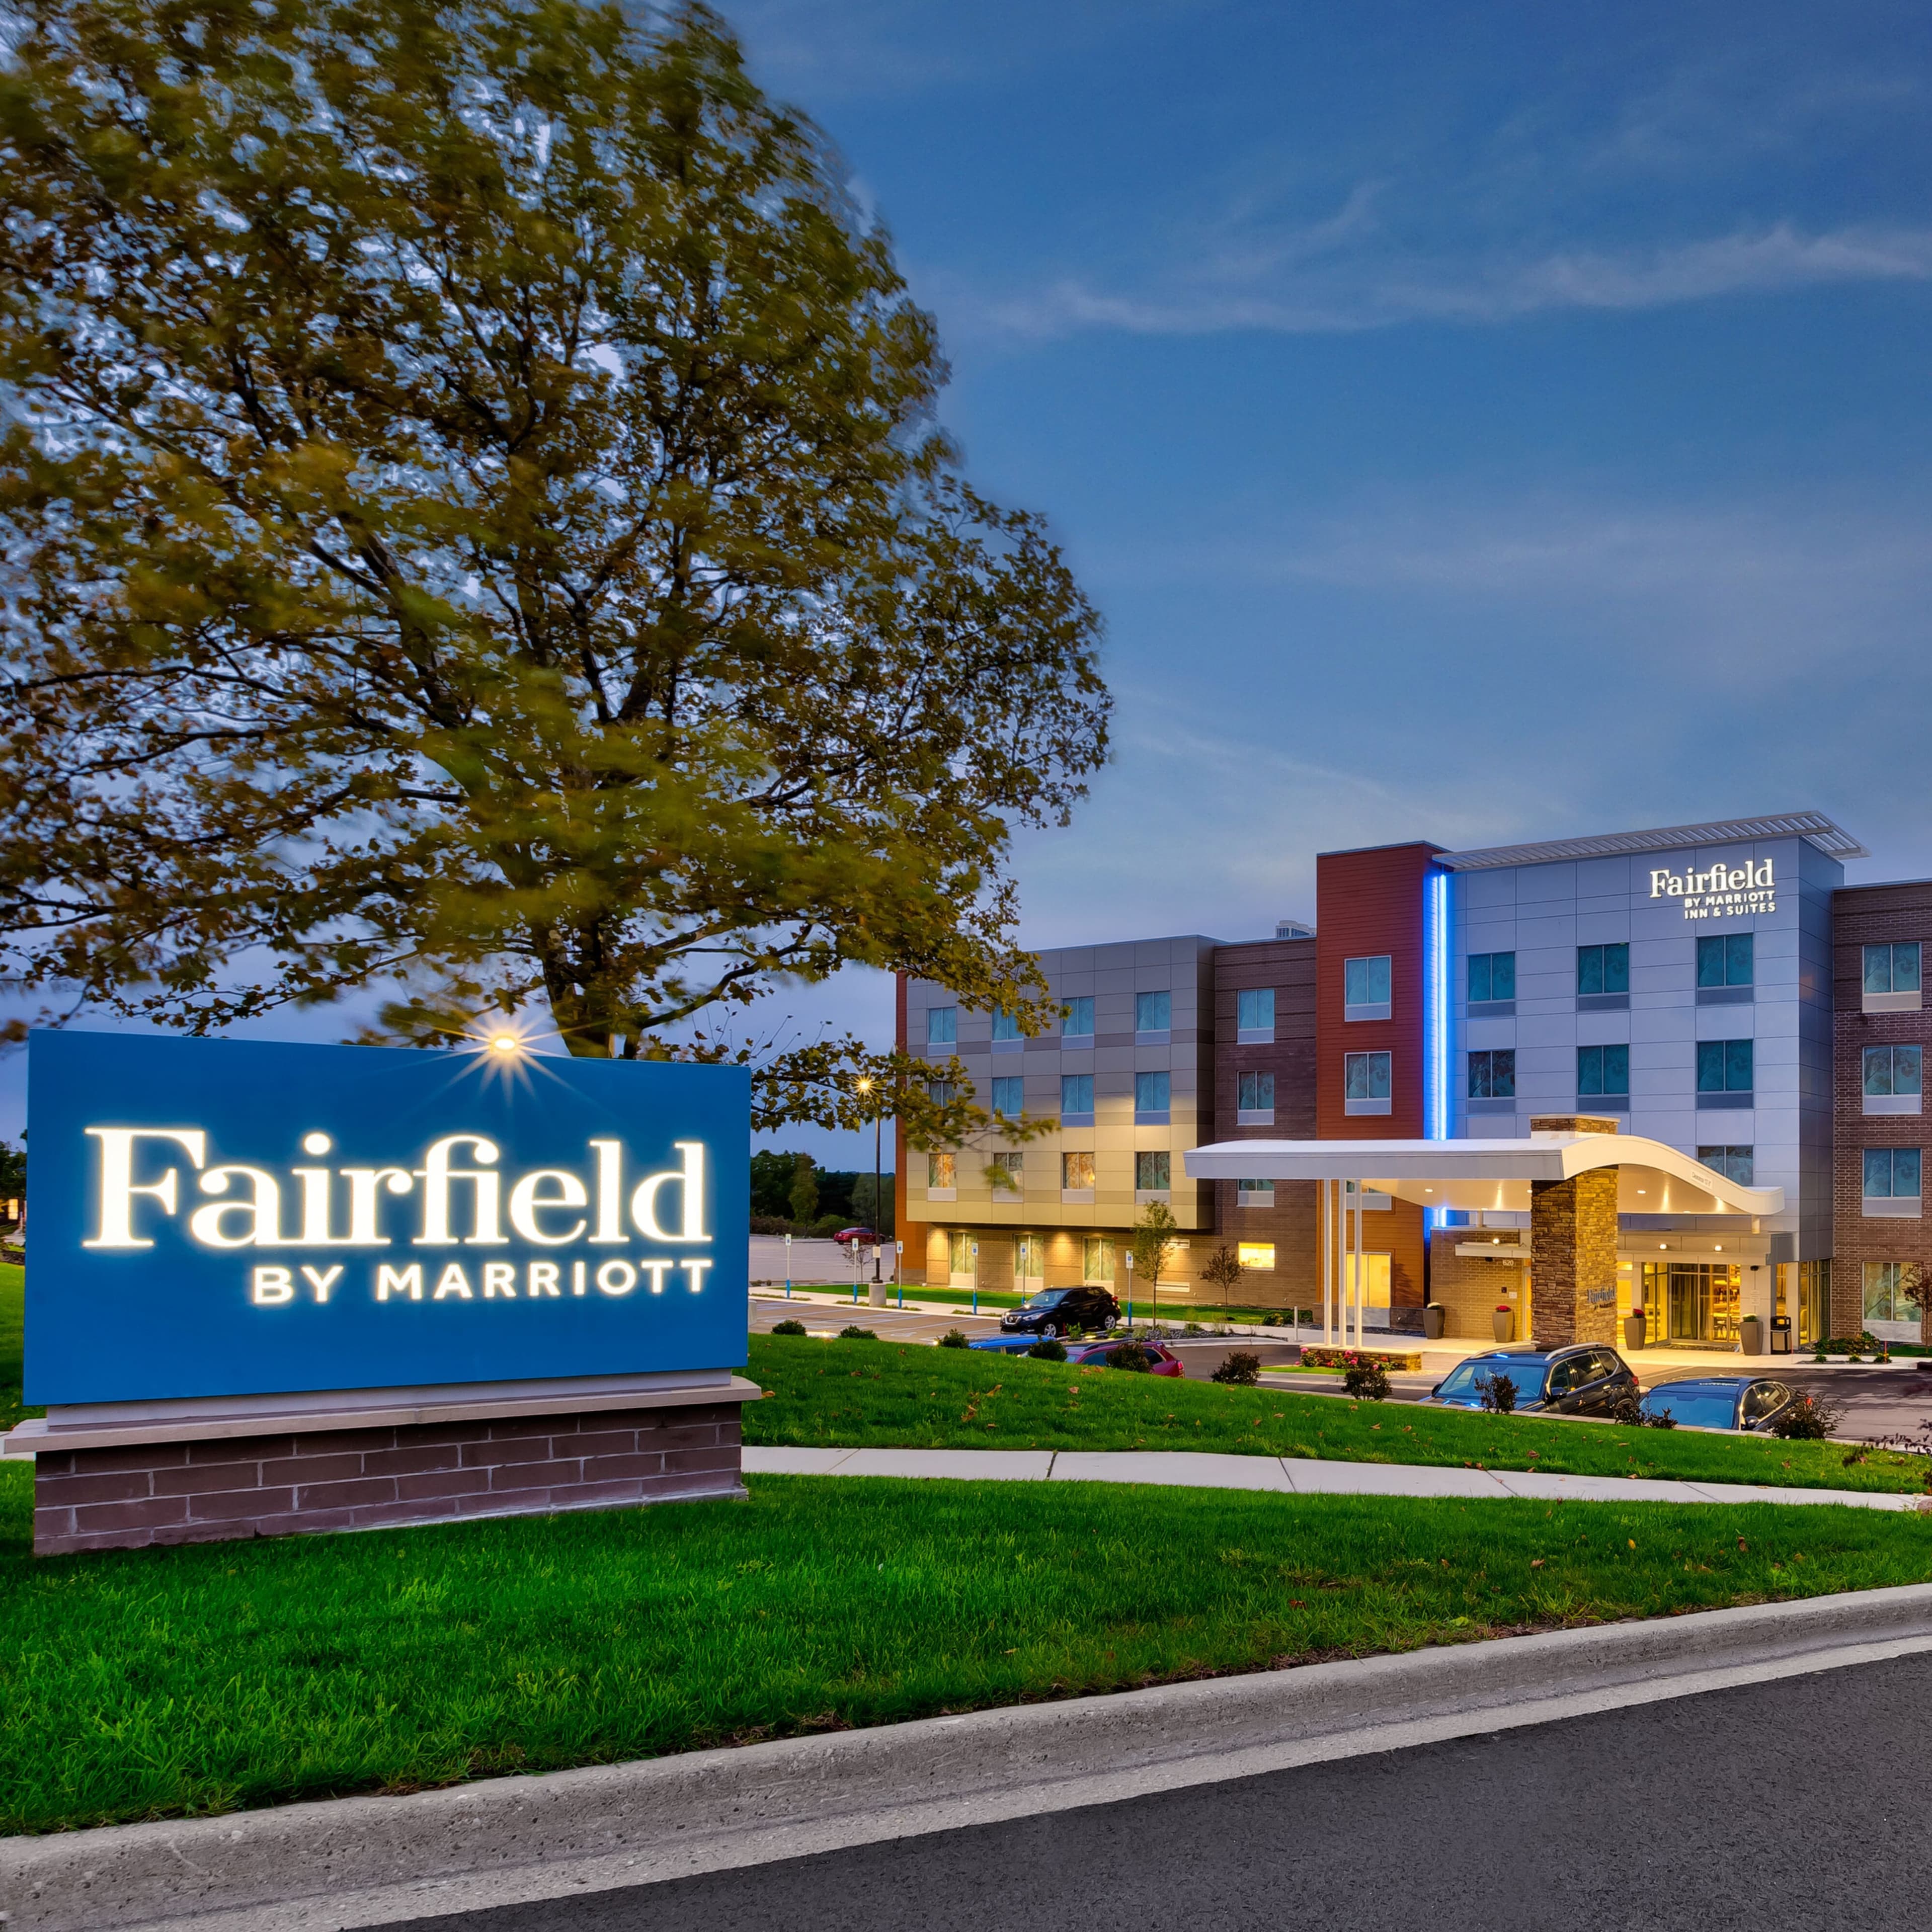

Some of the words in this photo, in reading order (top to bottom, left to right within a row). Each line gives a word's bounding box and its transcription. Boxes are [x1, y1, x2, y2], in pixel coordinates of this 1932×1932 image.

[1649, 858, 1775, 898] Fairfield
[1684, 897, 1701, 908] BY
[1705, 890, 1775, 906] MARRIOTT
[1684, 908, 1708, 919] INN
[1713, 907, 1721, 917] &
[1726, 902, 1776, 915] SUITES
[83, 1127, 712, 1249] Fairfield
[252, 1265, 344, 1305] BY
[376, 1258, 712, 1301] MARRIOTT
